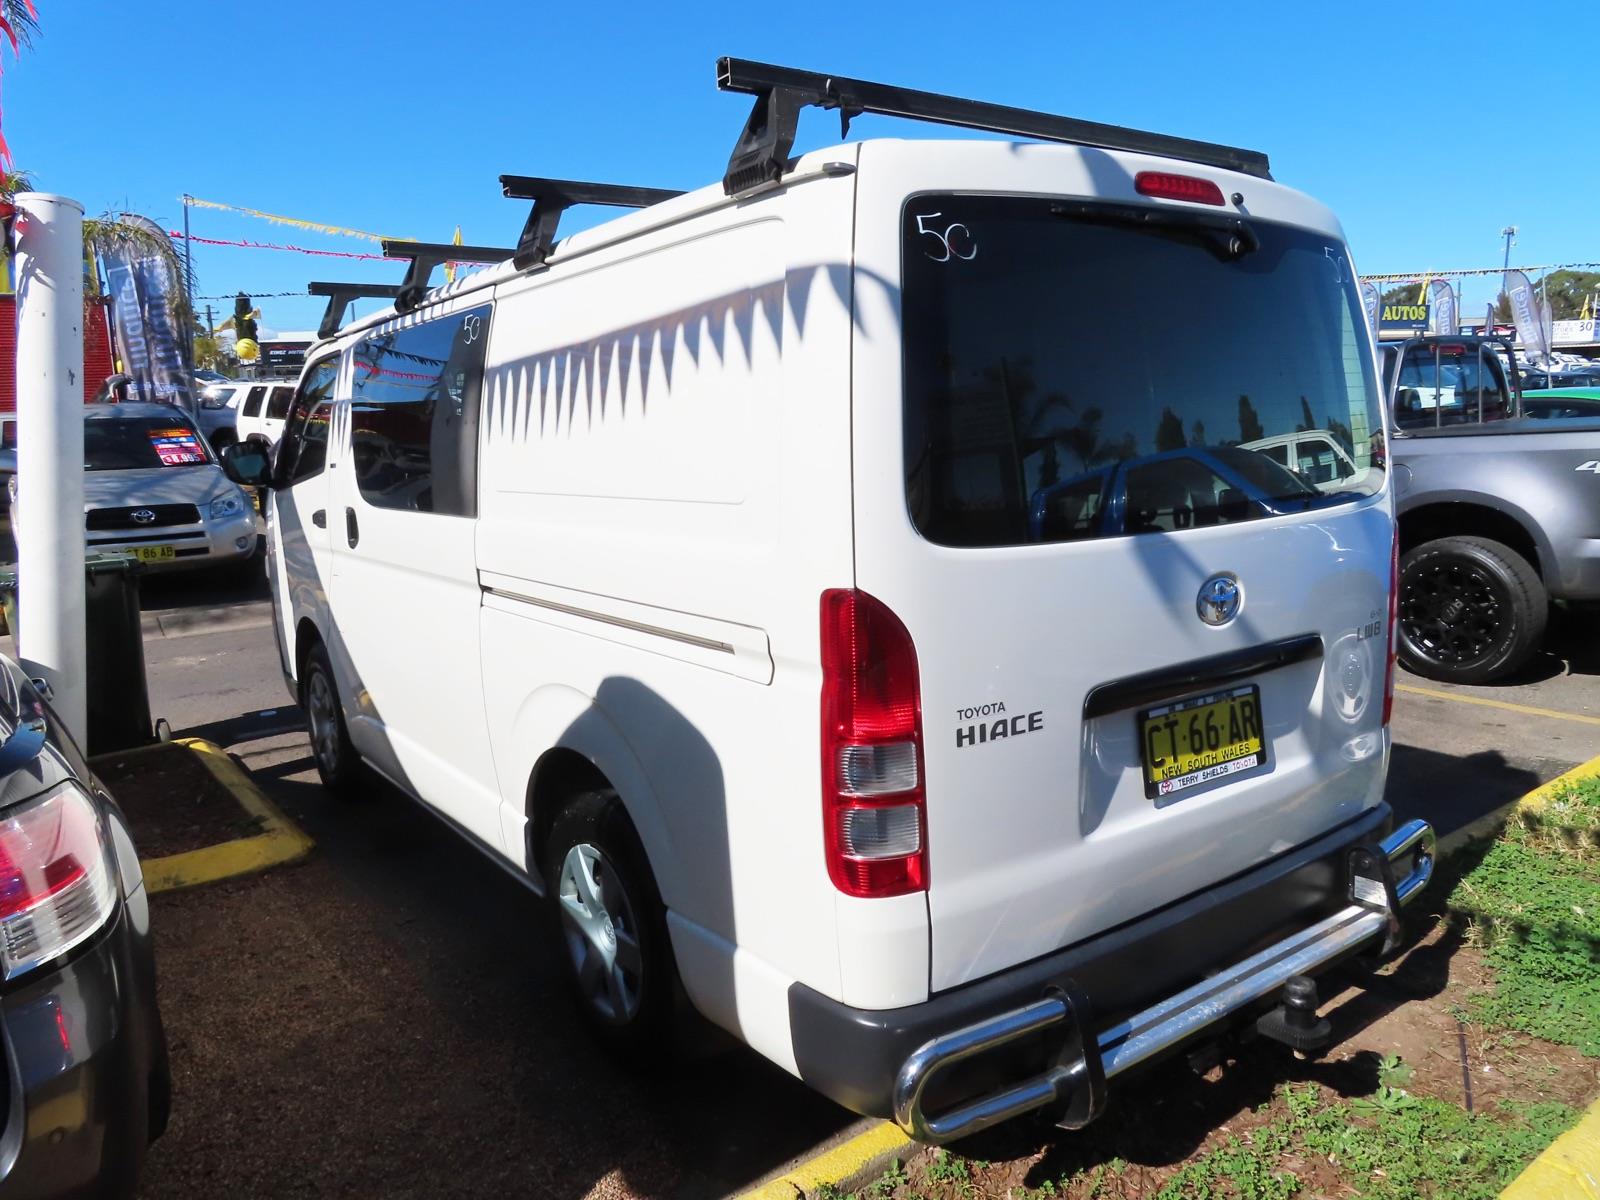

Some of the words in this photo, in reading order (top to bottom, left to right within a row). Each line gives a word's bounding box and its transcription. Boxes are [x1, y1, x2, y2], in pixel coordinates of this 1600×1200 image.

[916, 212, 977, 262] 50
[1382, 305, 1426, 321] AUTOS
[1579, 321, 1593, 332] 30
[463, 313, 480, 345] 50
[1357, 620, 1381, 641] LWB
[957, 701, 1006, 720] TOYOTA
[956, 711, 1043, 748] HIACE
[1161, 763, 1182, 780] NEW
[1187, 753, 1218, 771] SOUTH
[1221, 742, 1250, 761] WALES
[1178, 774, 1199, 787] TERRY
[1202, 764, 1229, 780] SHIELDS
[1232, 757, 1256, 771] TOYOTA
